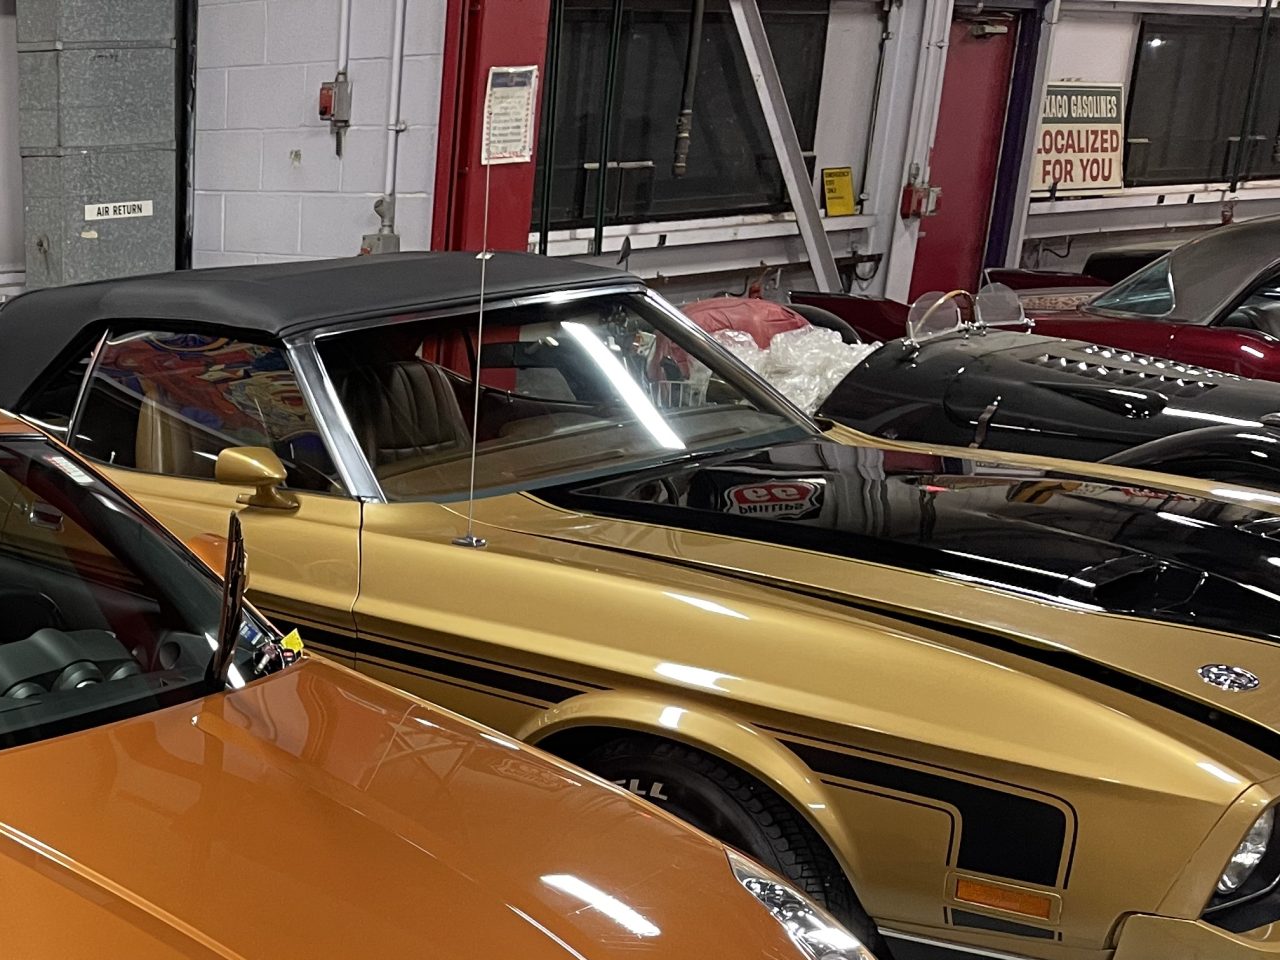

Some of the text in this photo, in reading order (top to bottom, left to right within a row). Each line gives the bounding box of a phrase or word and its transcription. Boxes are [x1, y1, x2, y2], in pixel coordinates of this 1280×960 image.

[1043, 94, 1117, 118] XACO GASOLINES
[1042, 157, 1112, 184] FOR YOU
[96, 203, 143, 217] AIR RETURN
